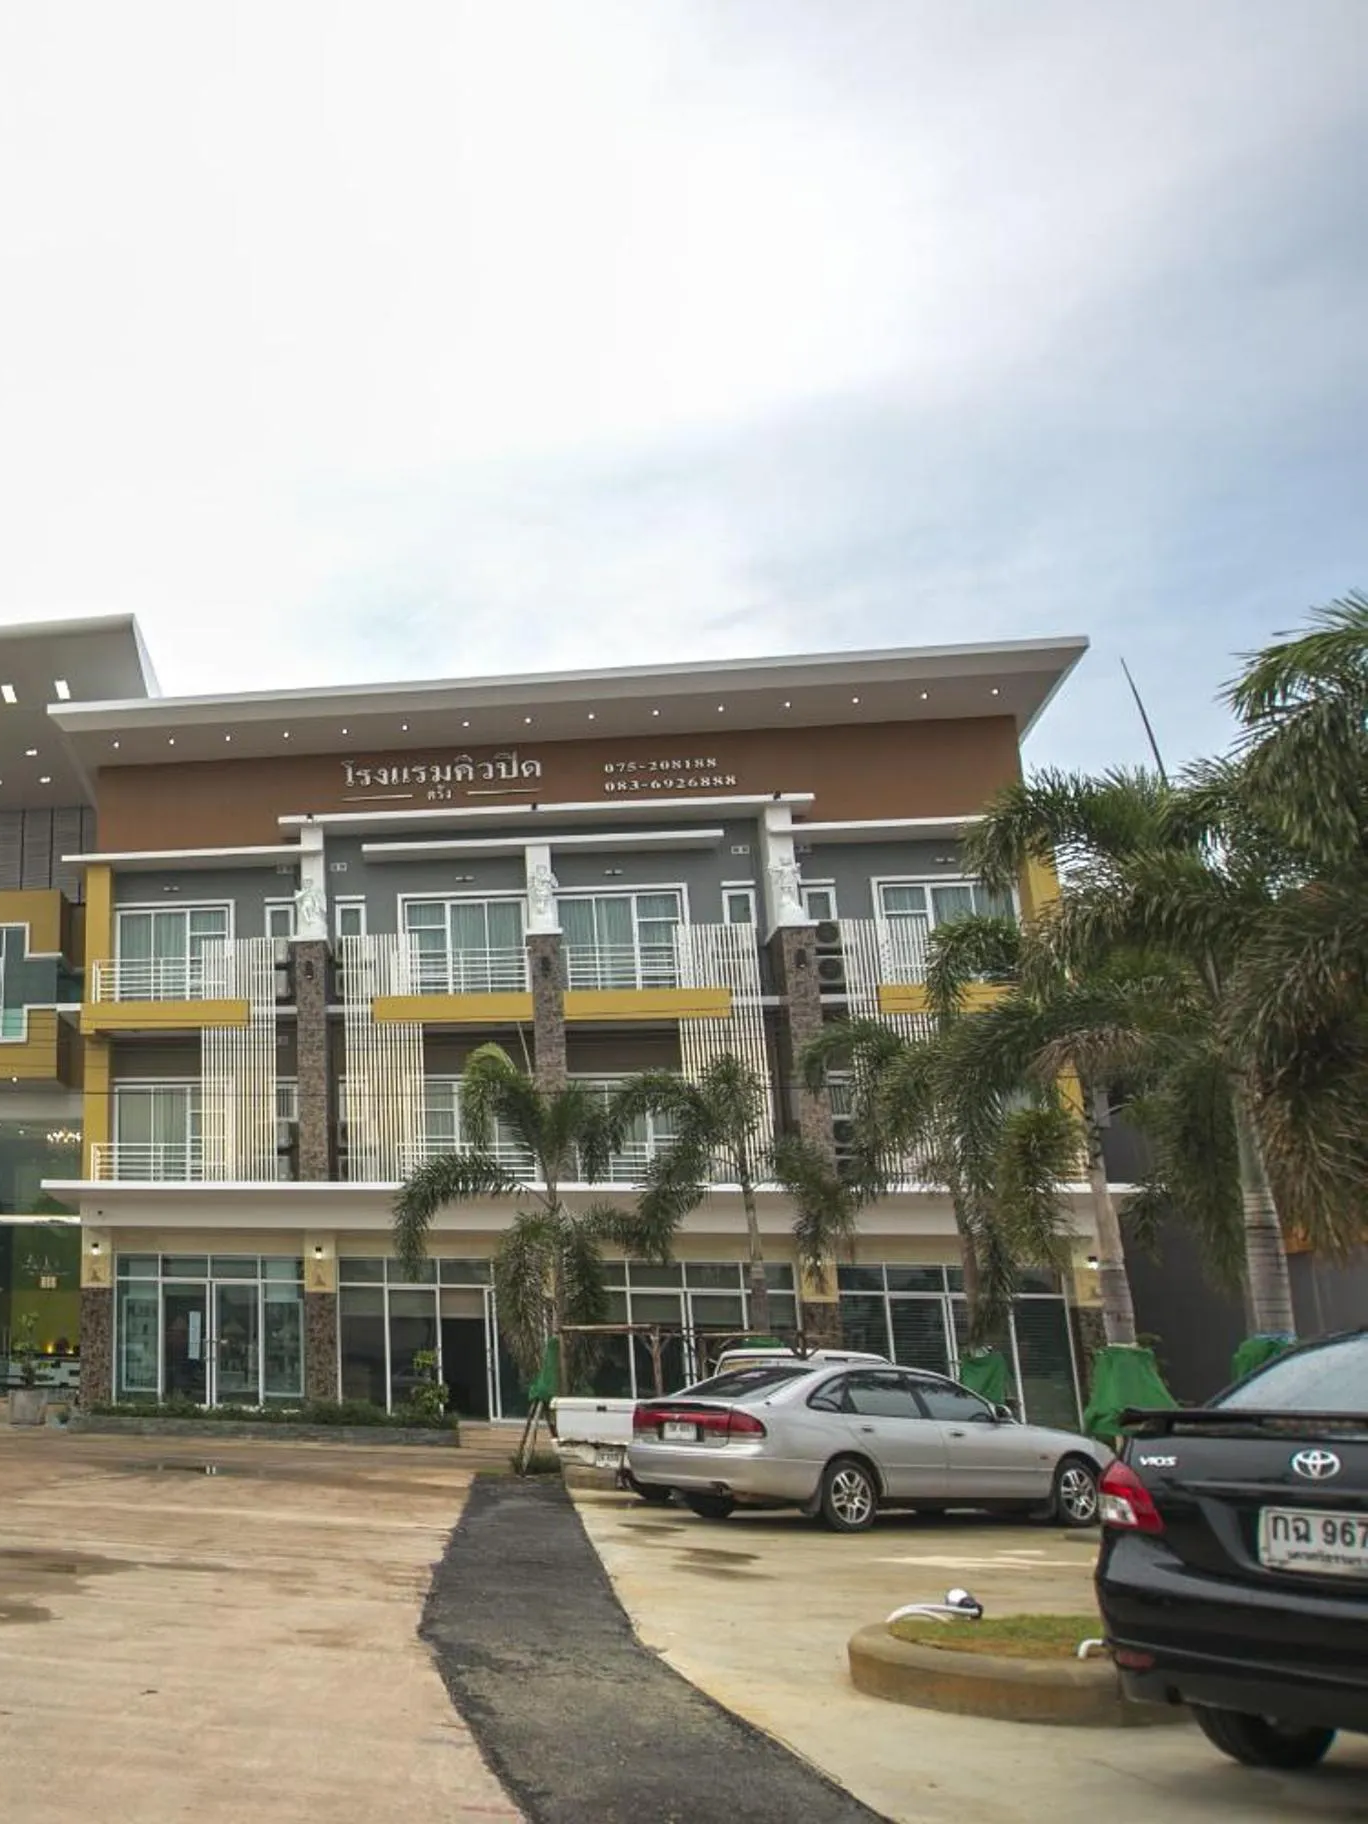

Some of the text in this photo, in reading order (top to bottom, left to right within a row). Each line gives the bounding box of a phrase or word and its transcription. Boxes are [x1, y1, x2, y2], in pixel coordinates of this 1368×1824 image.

[340, 751, 543, 787] โรงแรมคิวปิด
[604, 758, 717, 773] 075-208188
[604, 775, 738, 792] 083-6926888
[1139, 1455, 1178, 1467] VIOS
